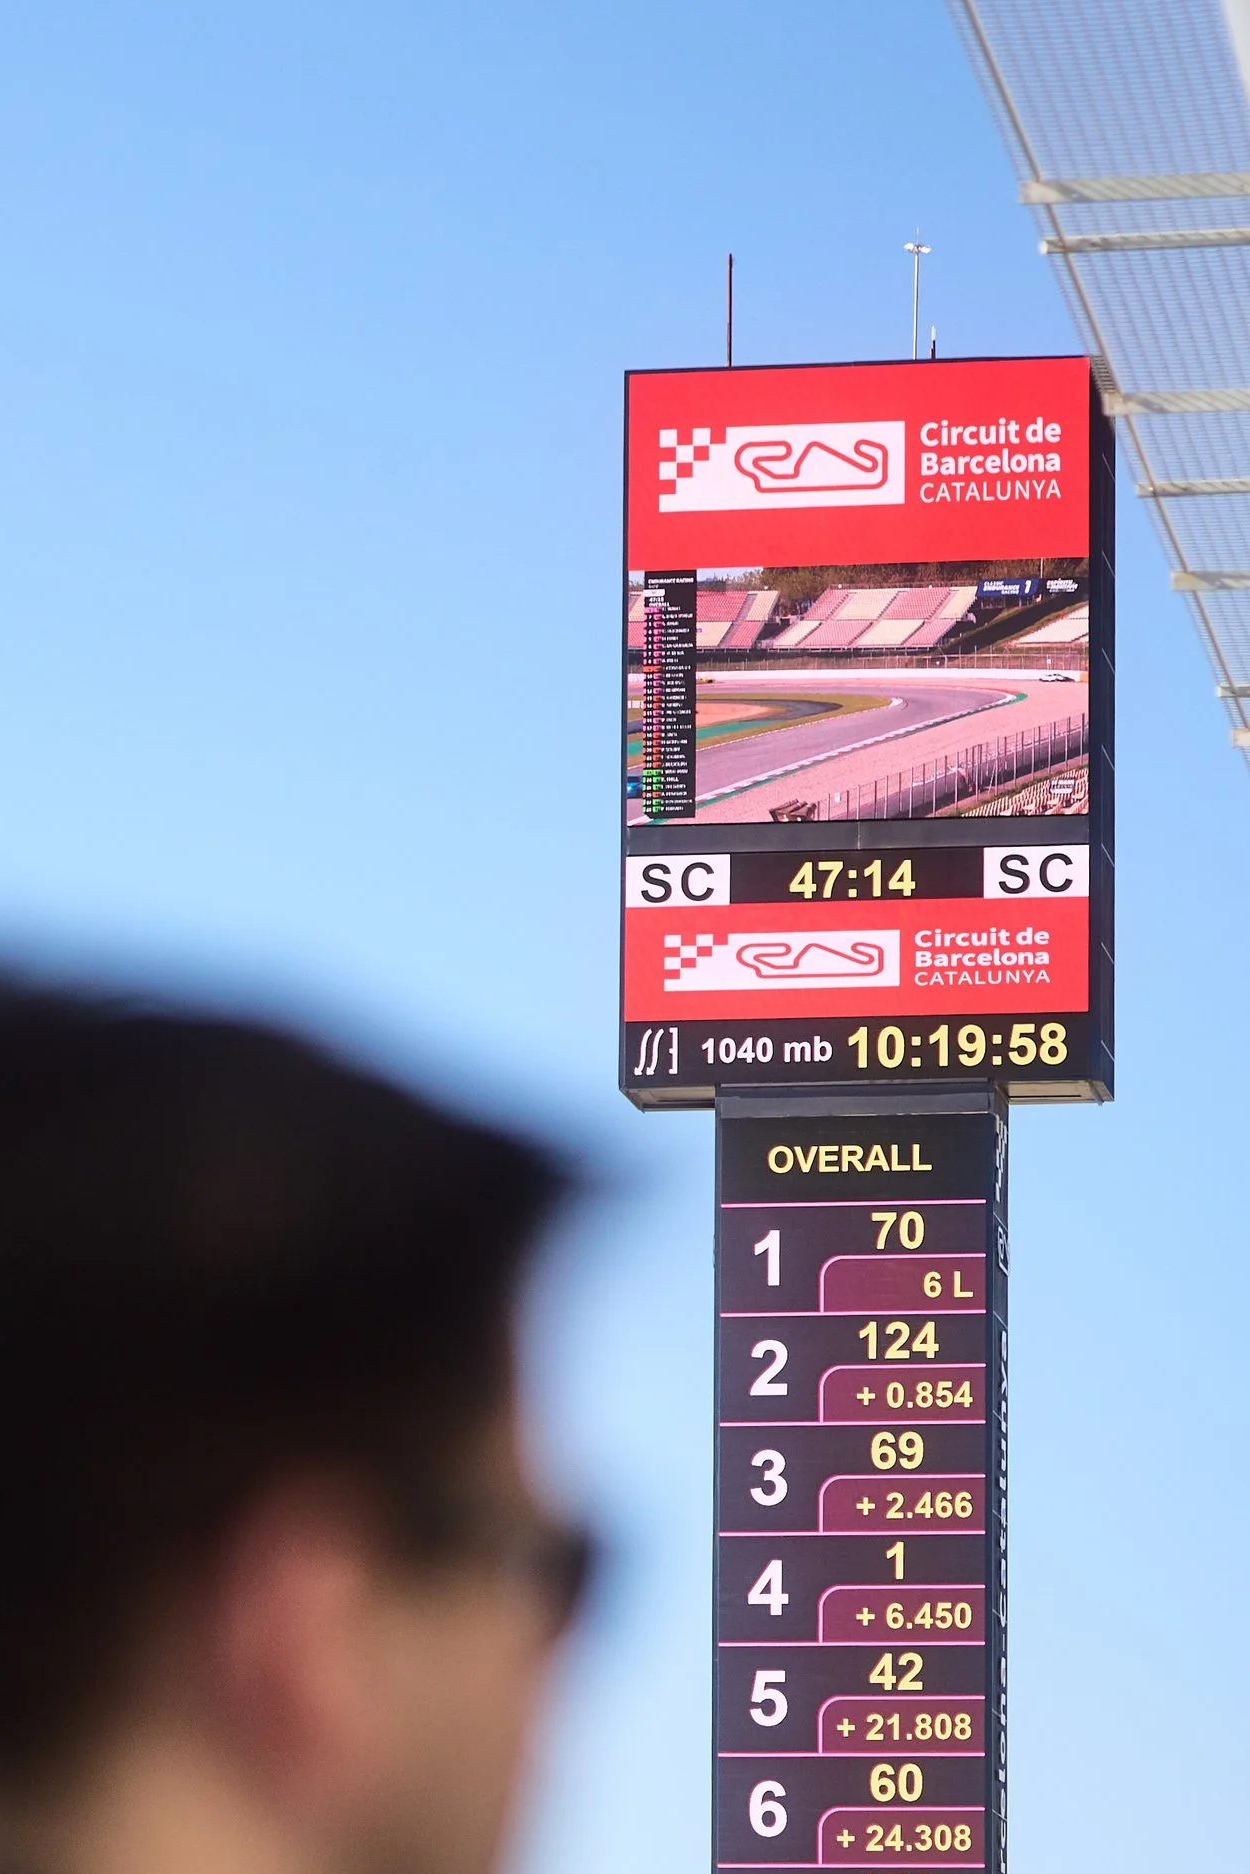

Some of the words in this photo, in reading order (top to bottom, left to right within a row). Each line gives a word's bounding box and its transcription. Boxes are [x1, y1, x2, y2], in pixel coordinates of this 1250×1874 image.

[921, 418, 1019, 446] Circuit
[1026, 417, 1061, 443] de
[921, 449, 1060, 475] Barcelona
[920, 480, 1060, 502] CATALUNYA
[641, 862, 714, 903] SC
[790, 860, 915, 898] 47:14
[999, 853, 1073, 893] SC
[915, 928, 1010, 947] Circuit
[1016, 927, 1049, 945] de
[916, 948, 1049, 967] Barcelona
[915, 970, 1050, 986] CATALUNYA
[702, 1037, 773, 1063] 1040
[785, 1036, 832, 1062] mb
[849, 1023, 1067, 1068] 10:19:58
[769, 1144, 932, 1173] OVERALL
[872, 1211, 924, 1249] 70
[755, 1230, 780, 1286] 1
[924, 1272, 941, 1297] 6
[954, 1271, 973, 1297] L
[860, 1322, 939, 1359] 124
[750, 1340, 787, 1395] 2
[857, 1387, 875, 1405] +
[887, 1381, 973, 1408] 0.854
[871, 1432, 923, 1469] 69
[751, 1450, 787, 1506] 3
[857, 1497, 875, 1515] +
[886, 1492, 972, 1518] 2.466
[887, 1543, 903, 1579] 1
[748, 1560, 788, 1615] 4
[856, 1608, 875, 1626] +
[886, 1603, 971, 1629] 6.450
[870, 1654, 922, 1690] 42
[750, 1670, 787, 1726] 5
[837, 1719, 855, 1737] +
[866, 1713, 971, 1740] 21.808
[871, 1765, 922, 1801] 60
[750, 1781, 787, 1837] 6
[837, 1830, 855, 1847] +
[866, 1825, 971, 1851] 24.308
